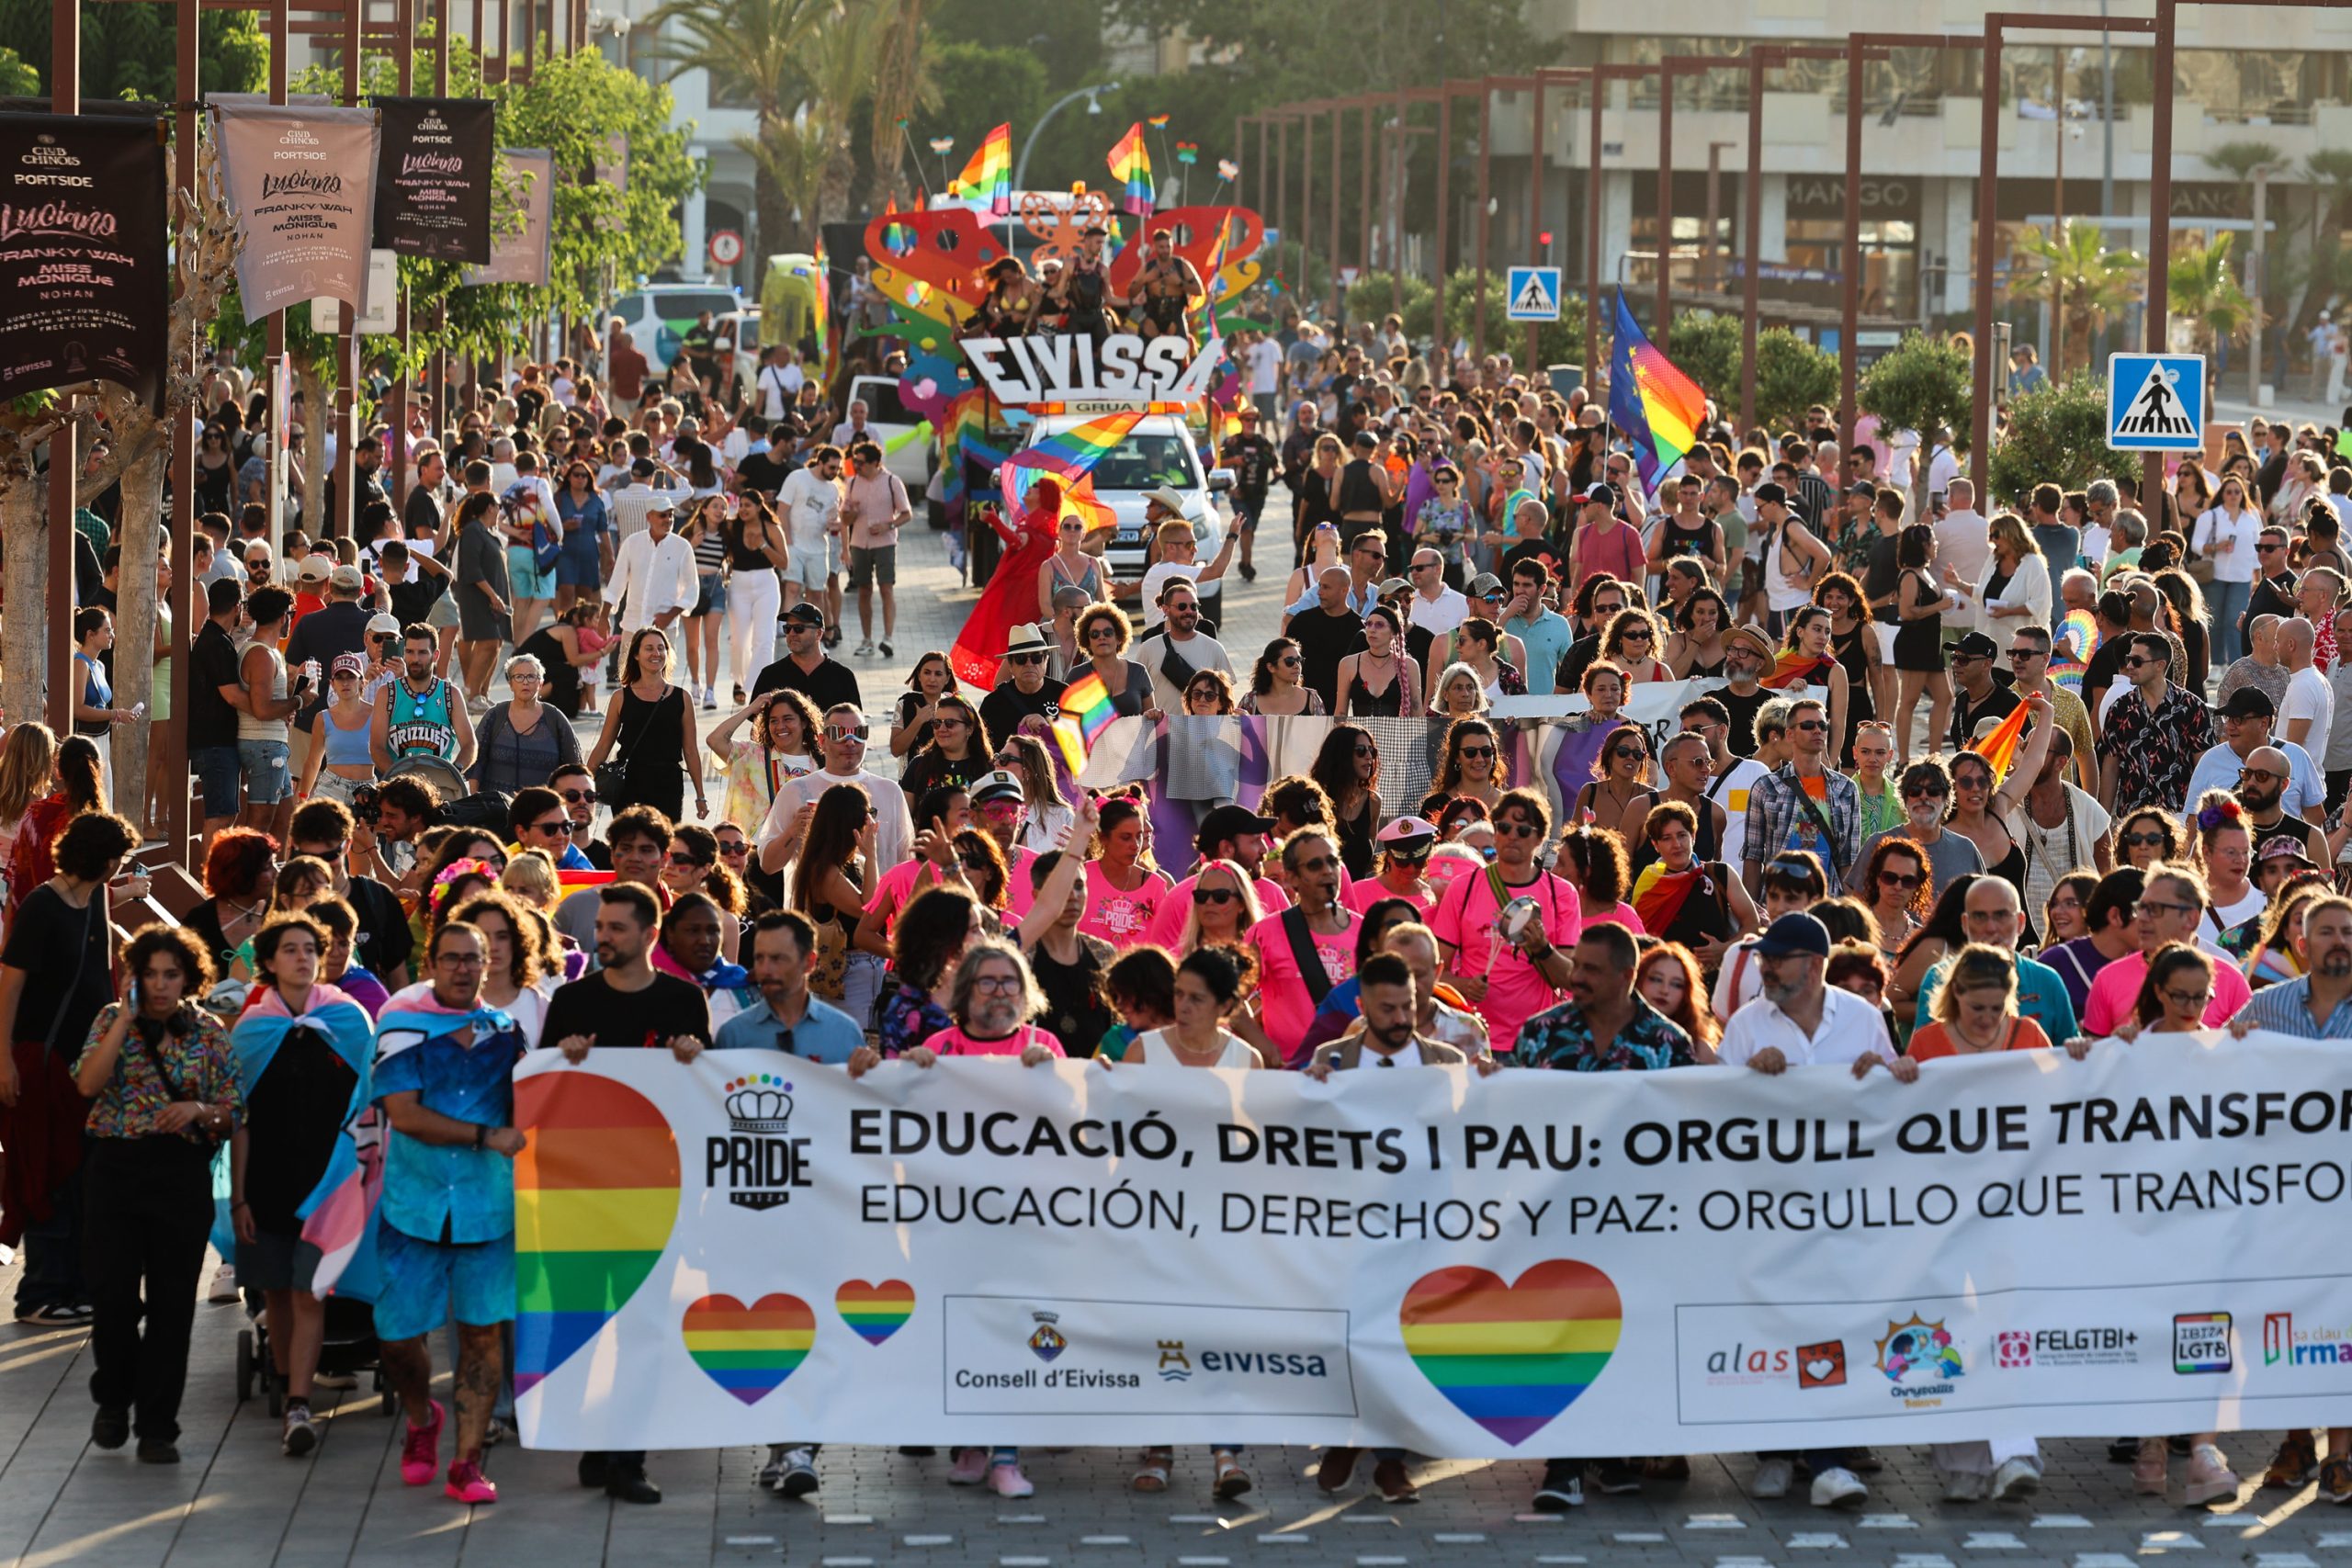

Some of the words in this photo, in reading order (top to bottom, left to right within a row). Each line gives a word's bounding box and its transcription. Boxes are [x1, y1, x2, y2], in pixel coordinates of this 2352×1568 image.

[287, 130, 311, 138] CLUB
[413, 135, 453, 144] PORTSIDE
[279, 137, 320, 145] CHINOIS
[31, 147, 68, 156] CLUB
[274, 152, 327, 160] PORTSIDE
[21, 154, 81, 166] CHINOIS
[14, 175, 95, 187] PORTSIDE
[254, 203, 317, 218] FRANKY
[320, 203, 353, 215] WAH
[288, 214, 322, 222] MISS
[273, 221, 337, 232] MONIQUE
[287, 232, 323, 242] NOHAN
[86, 249, 134, 267] WAH
[39, 264, 93, 274] MISS
[17, 274, 115, 287] MONIQUE
[40, 290, 95, 300] NOHAN
[14, 359, 53, 375] eivissa
[958, 333, 1226, 404] EIVISSA
[1076, 402, 1134, 412] GRUA
[334, 659, 356, 670] IBIZA
[388, 724, 451, 757] GRIZZLIES
[1105, 911, 1136, 930] PRIDE
[850, 1109, 1193, 1168] EDUCACIÓ,
[1216, 1123, 1407, 1174] DRETS
[1427, 1126, 1442, 1170] I
[1464, 1125, 1600, 1171] PAU:
[1623, 1118, 1874, 1166] ORGULL
[1896, 1105, 2030, 1154] QUE
[707, 1136, 812, 1188] PRIDE
[735, 1194, 786, 1202] IBIZA
[861, 1179, 1199, 1238] EDUCACIÓN,
[1220, 1192, 1501, 1241] DERECHOS
[1519, 1200, 1552, 1237] Y
[1569, 1196, 1679, 1234] PAZ:
[1699, 1183, 1958, 1233] ORGULLO
[1977, 1175, 2084, 1219] QUE
[2035, 1328, 2138, 1351] FELGTBI+
[2180, 1326, 2224, 1340] IBIZA
[2179, 1342, 2227, 1359] LGTB
[1201, 1350, 1327, 1377] eivissa
[1707, 1343, 1790, 1373] alas
[956, 1370, 1036, 1388] Consell
[1044, 1369, 1140, 1388] d'Eivissa
